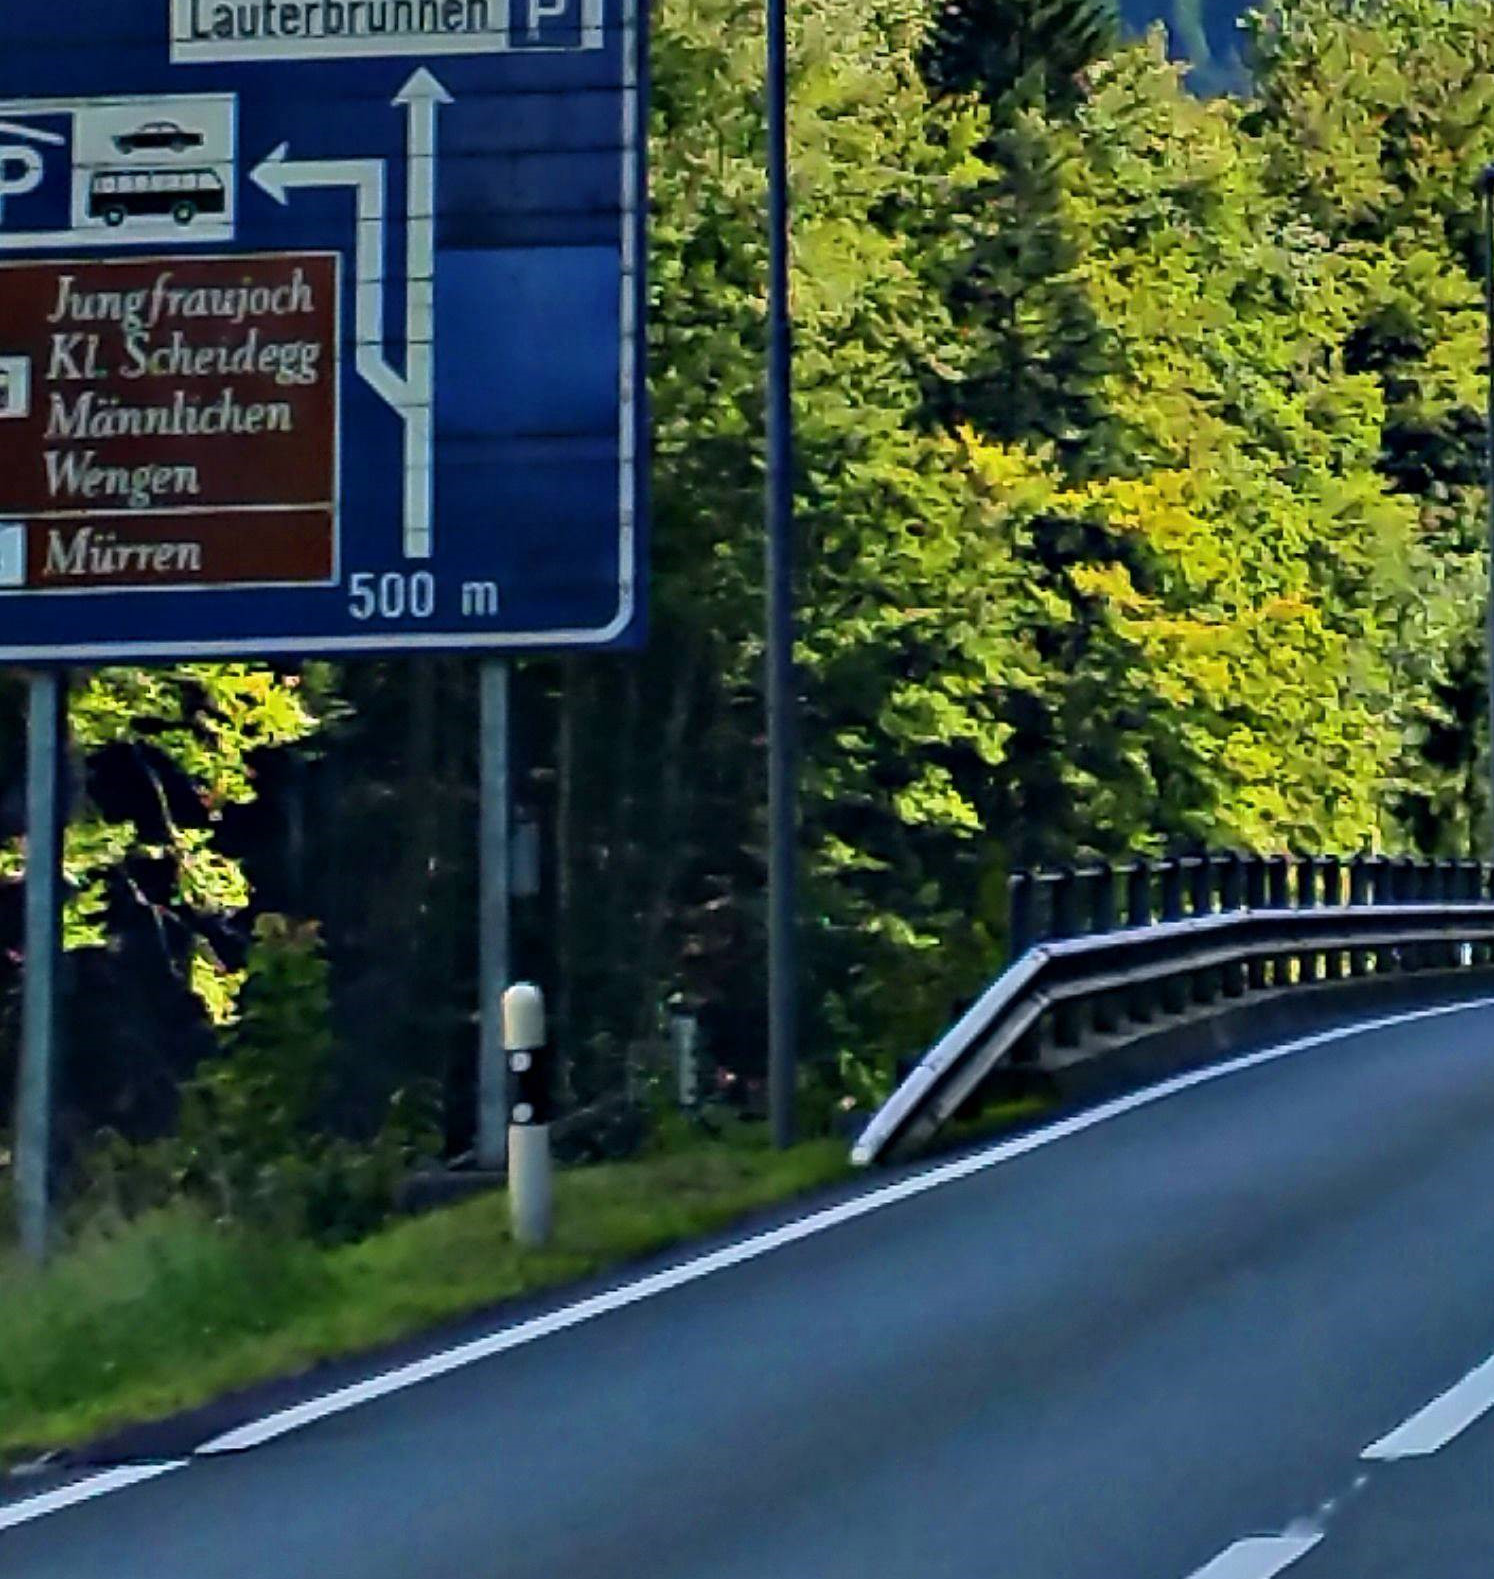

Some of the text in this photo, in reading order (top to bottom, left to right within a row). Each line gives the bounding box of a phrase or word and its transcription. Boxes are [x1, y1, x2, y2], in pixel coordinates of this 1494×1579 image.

[47, 268, 314, 332] Jungfraujoch
[119, 328, 321, 384] Scheidegg
[44, 388, 293, 440] Männlichen
[43, 450, 200, 506] Wengen
[43, 528, 201, 577] Mürren
[349, 573, 498, 620] 500 m
